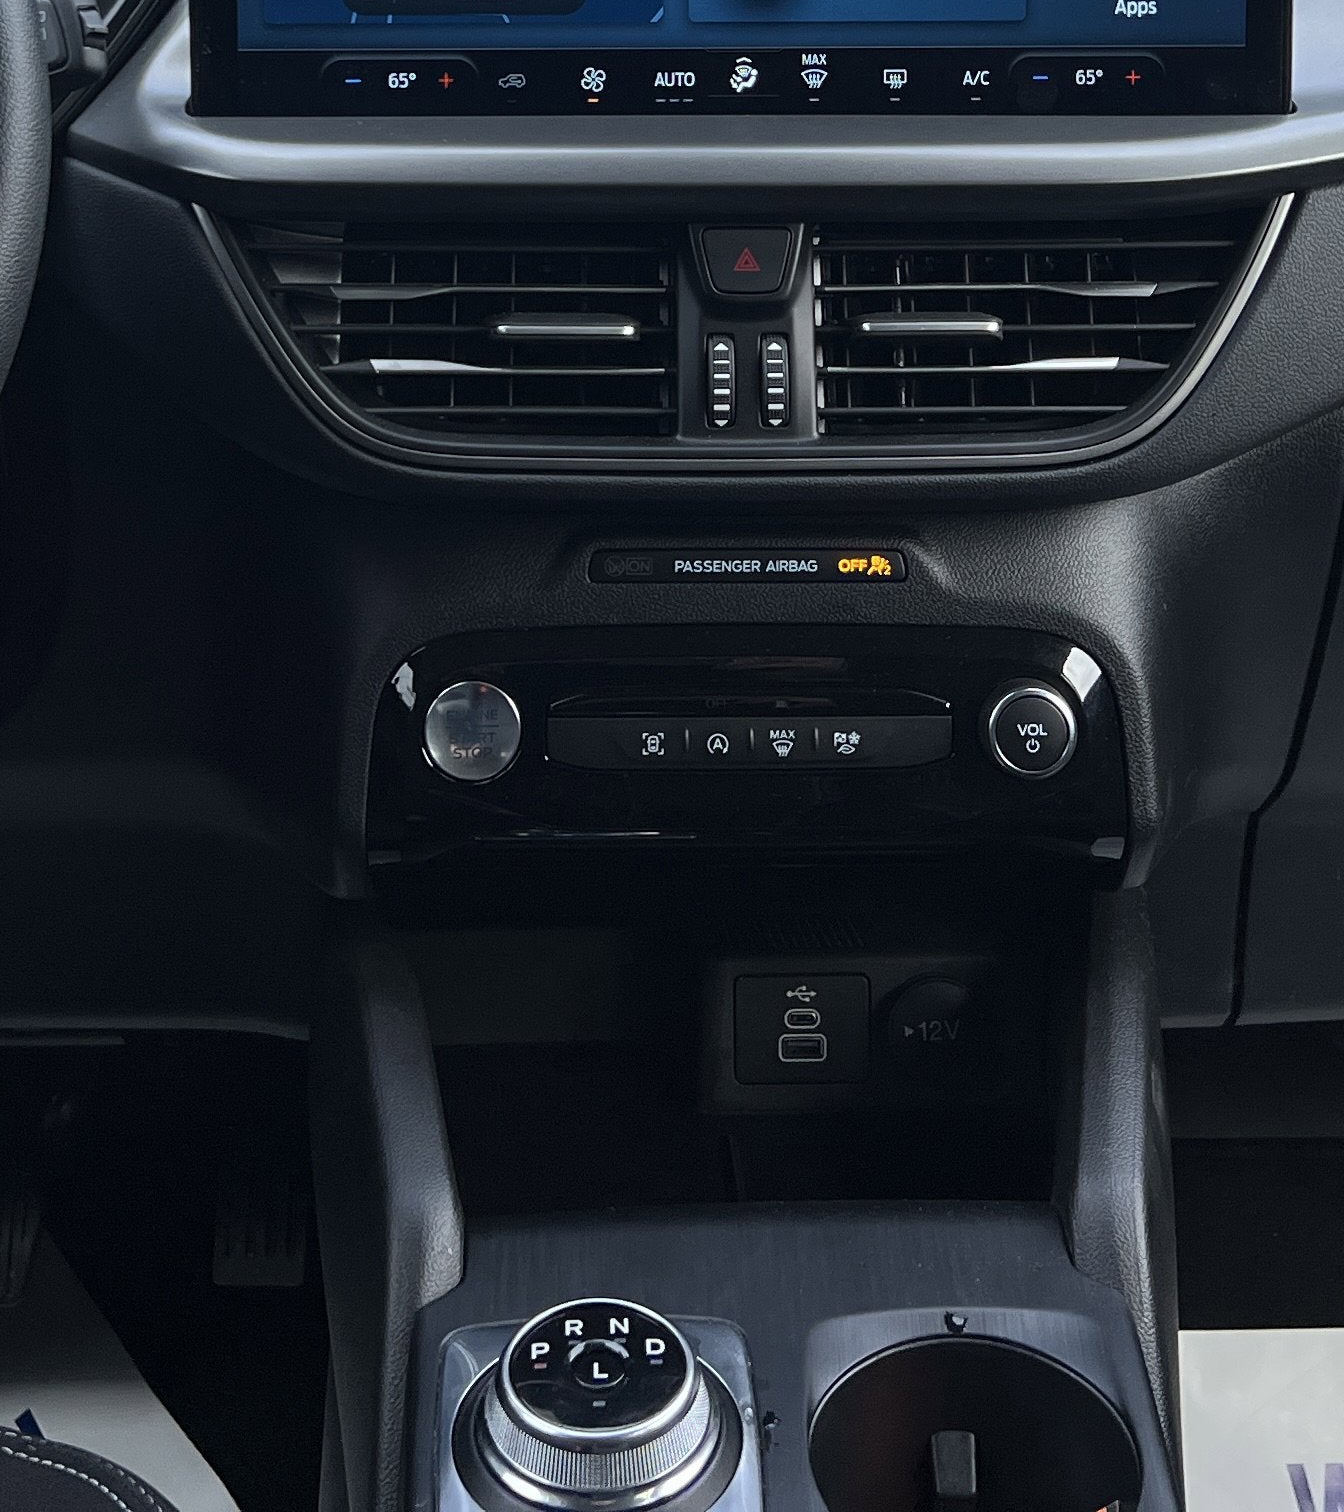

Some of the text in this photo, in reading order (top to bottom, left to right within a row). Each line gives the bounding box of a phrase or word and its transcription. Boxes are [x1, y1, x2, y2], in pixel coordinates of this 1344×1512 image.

[801, 53, 827, 66] MAX
[388, 72, 417, 89] 65°
[654, 71, 696, 87] AUTO
[962, 70, 990, 86] A/C
[1075, 69, 1104, 85] 65°
[674, 559, 818, 573] PASSENGER AIRBAG
[838, 558, 868, 574] OFF
[446, 708, 498, 721] ENE
[449, 732, 497, 744] SRT
[769, 729, 796, 740] MAX
[1016, 723, 1048, 737] VOL
[453, 746, 493, 759] STOP
[918, 1019, 960, 1041] 12V
[564, 1317, 630, 1337] R N
[530, 1342, 550, 1360] P
[645, 1338, 666, 1356] D
[592, 1361, 609, 1379] L
